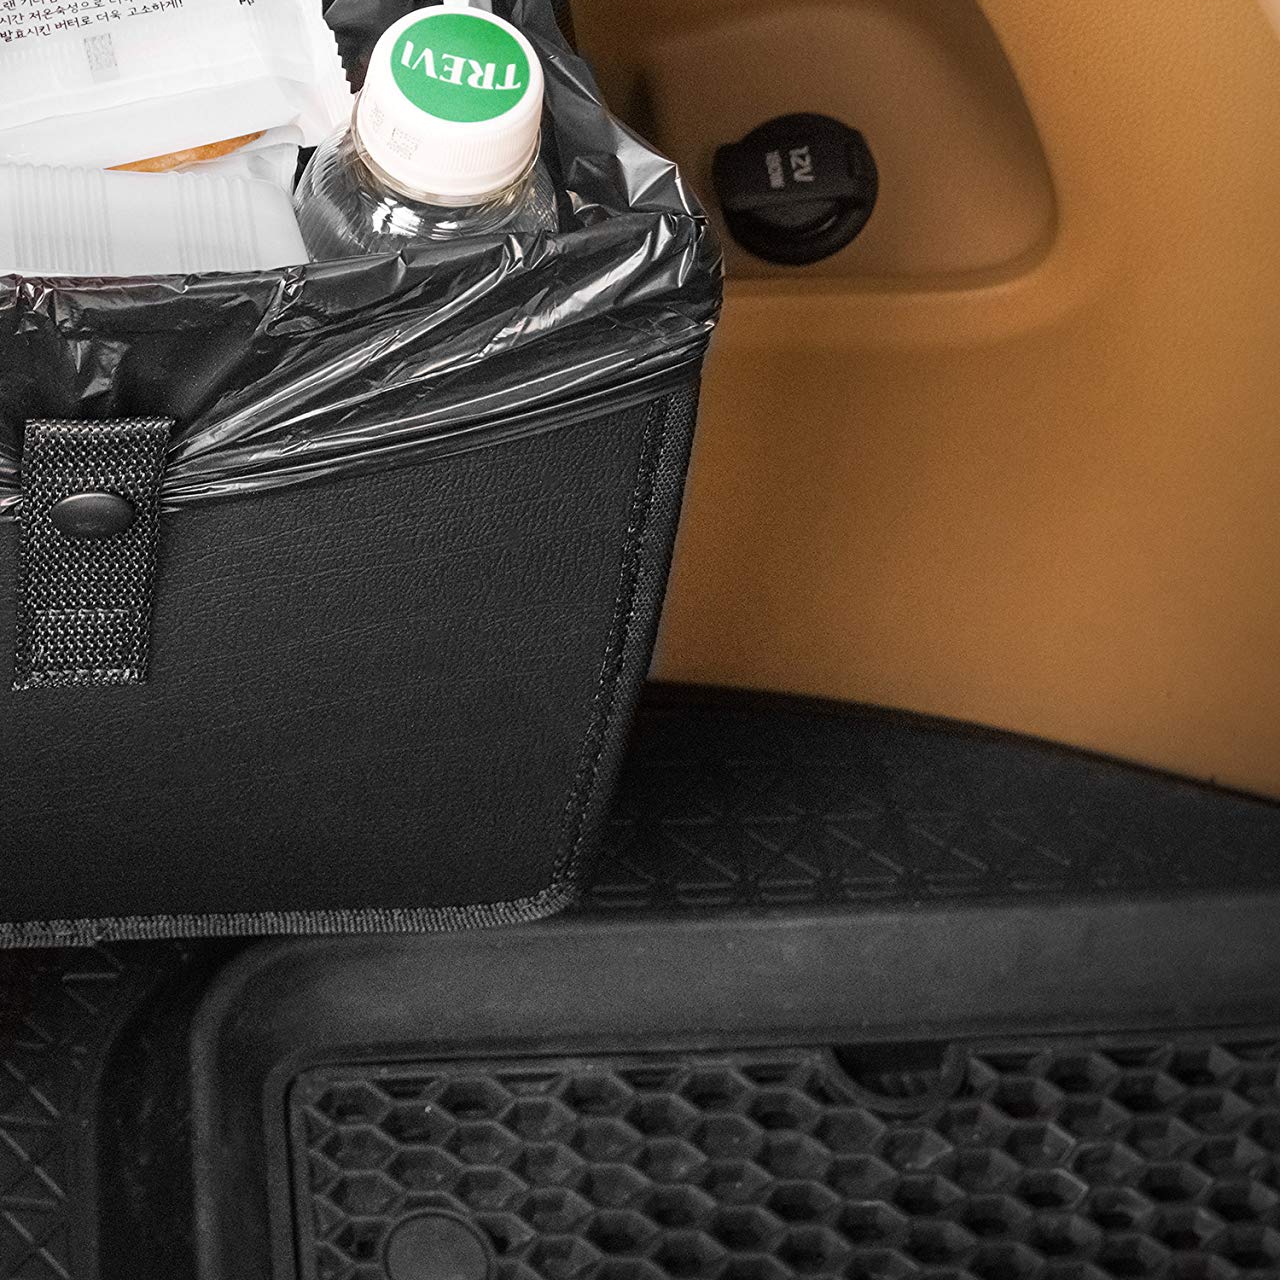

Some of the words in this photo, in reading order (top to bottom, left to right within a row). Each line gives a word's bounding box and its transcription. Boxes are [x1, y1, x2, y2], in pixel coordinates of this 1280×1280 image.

[0, 24, 51, 43] 발효시킨
[55, 16, 93, 30] 버터로
[96, 9, 122, 23] 더욱
[29, 0, 106, 21] 저온숙성으로
[401, 40, 521, 90] TREVI
[789, 145, 815, 182] 12V
